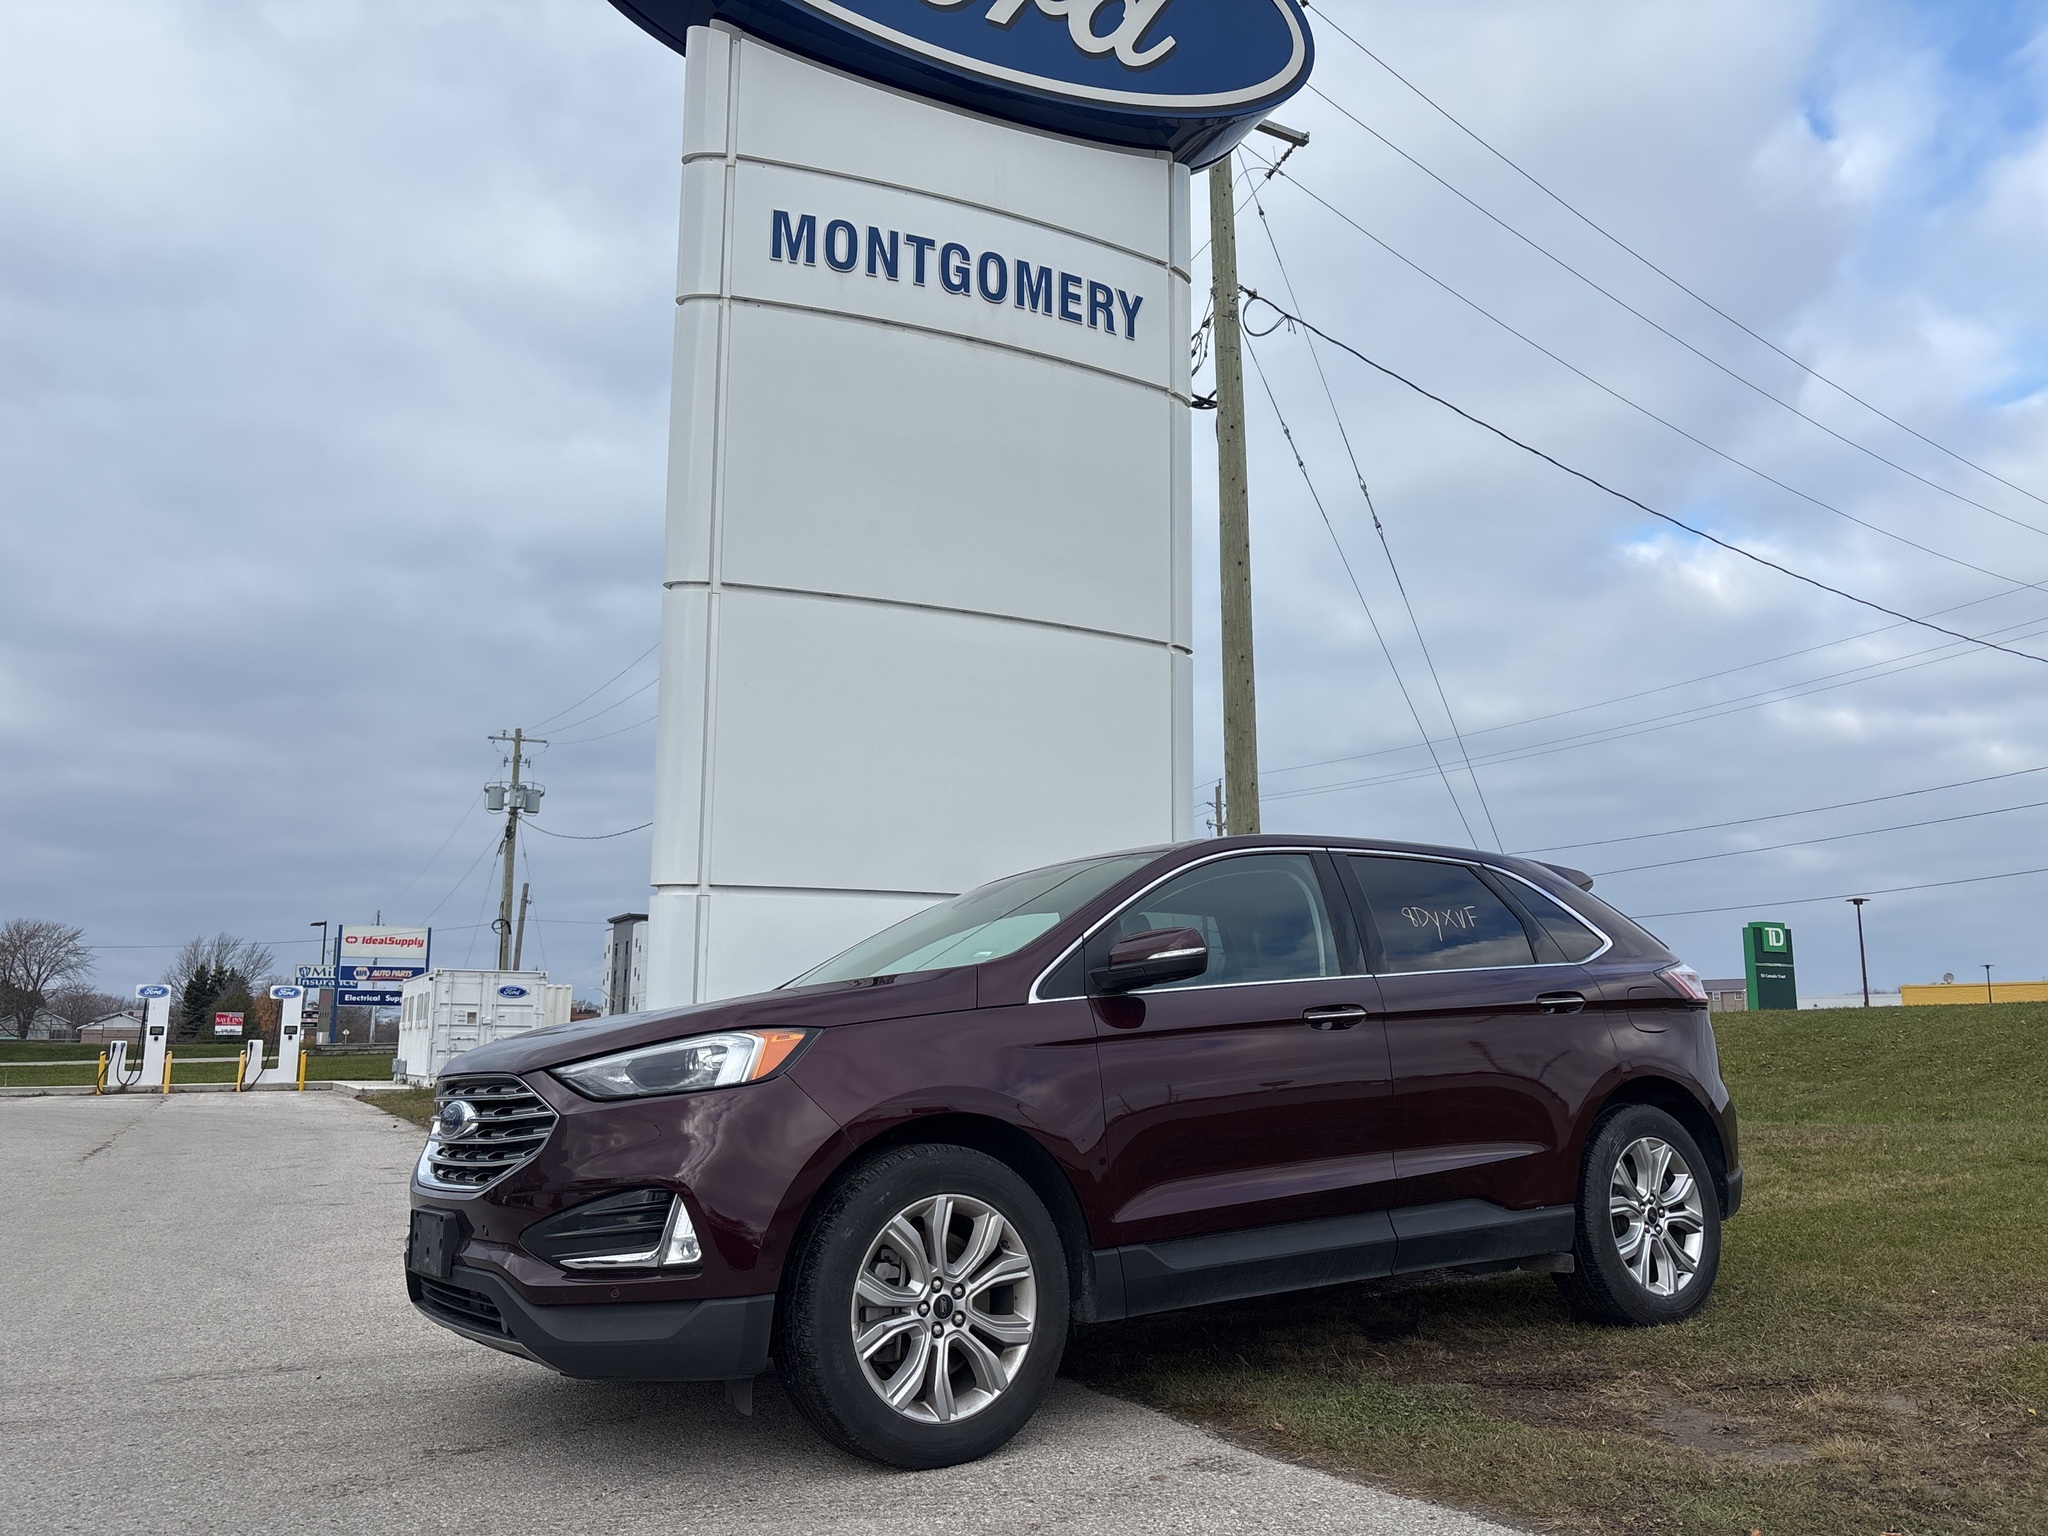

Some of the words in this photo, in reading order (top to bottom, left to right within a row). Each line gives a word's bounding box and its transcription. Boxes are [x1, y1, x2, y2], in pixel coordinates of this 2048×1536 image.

[769, 208, 1145, 342] MONTGOMERY
[361, 936, 425, 948] IdealSupply
[1764, 927, 1784, 946] TD
[371, 969, 391, 977] AUTO
[344, 994, 381, 1002] Electrical
